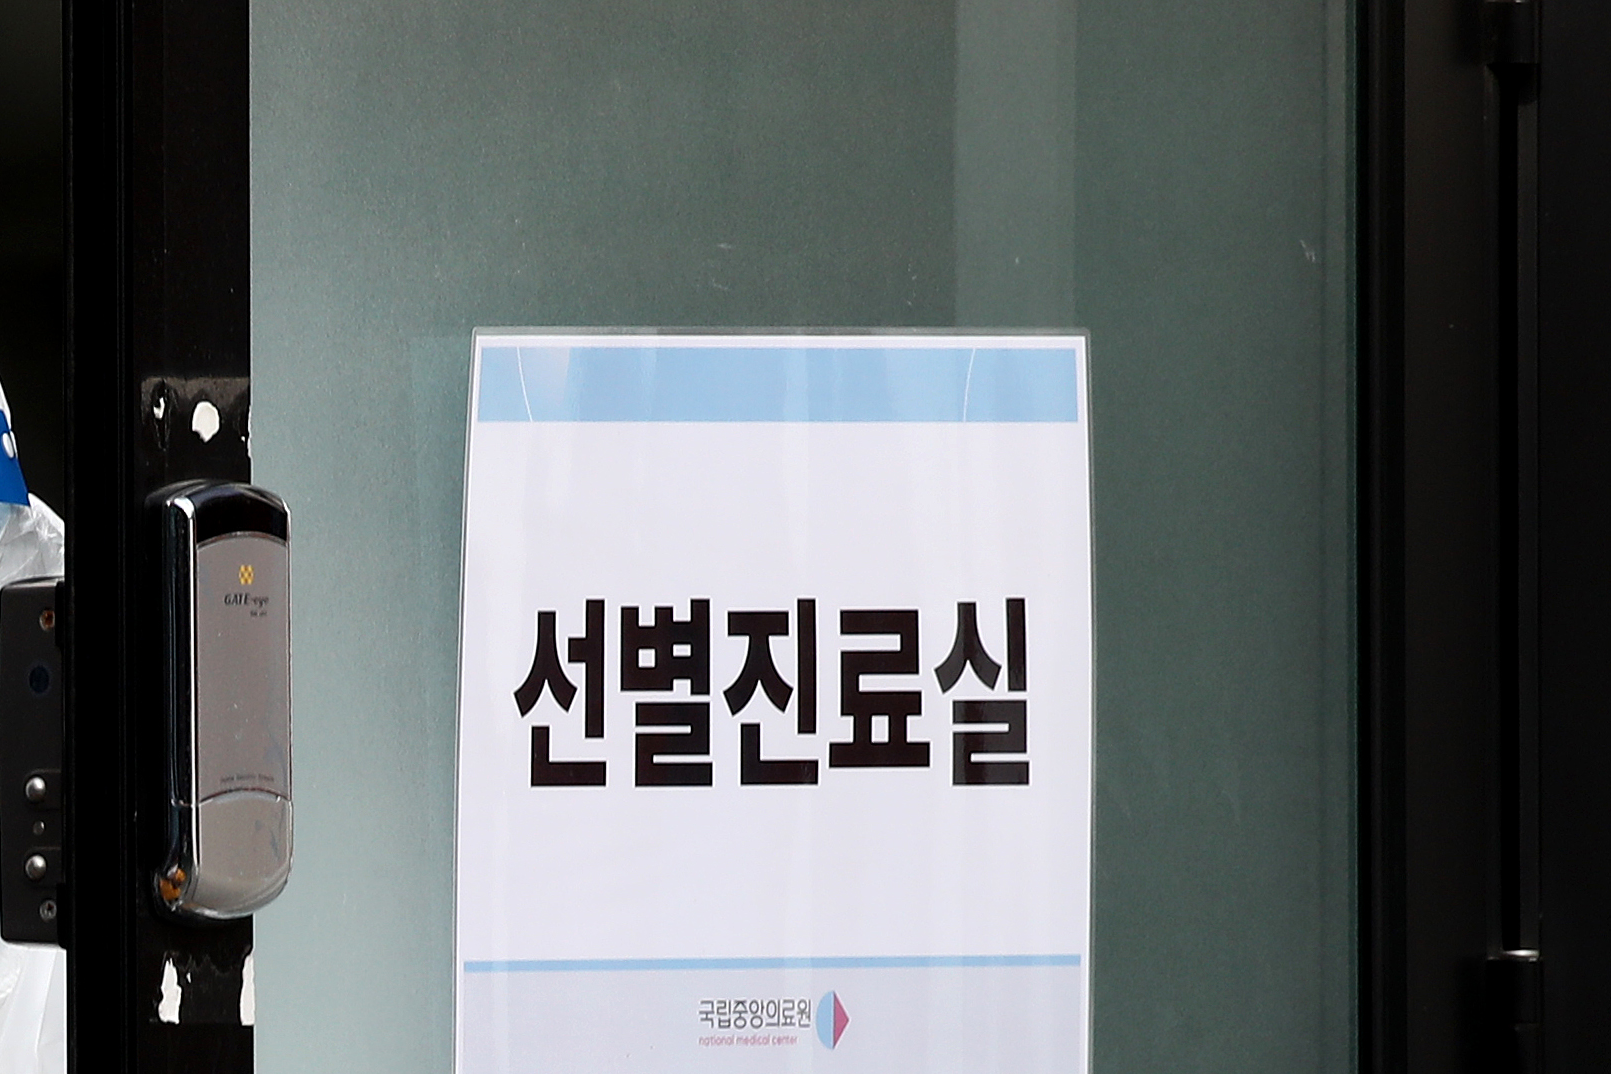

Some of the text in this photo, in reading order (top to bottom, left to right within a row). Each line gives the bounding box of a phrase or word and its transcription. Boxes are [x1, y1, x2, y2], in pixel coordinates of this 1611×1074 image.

[513, 597, 1030, 788] 선별진료실
[698, 998, 811, 1030] 국립중앙의료원
[698, 1033, 798, 1047] national medical center
